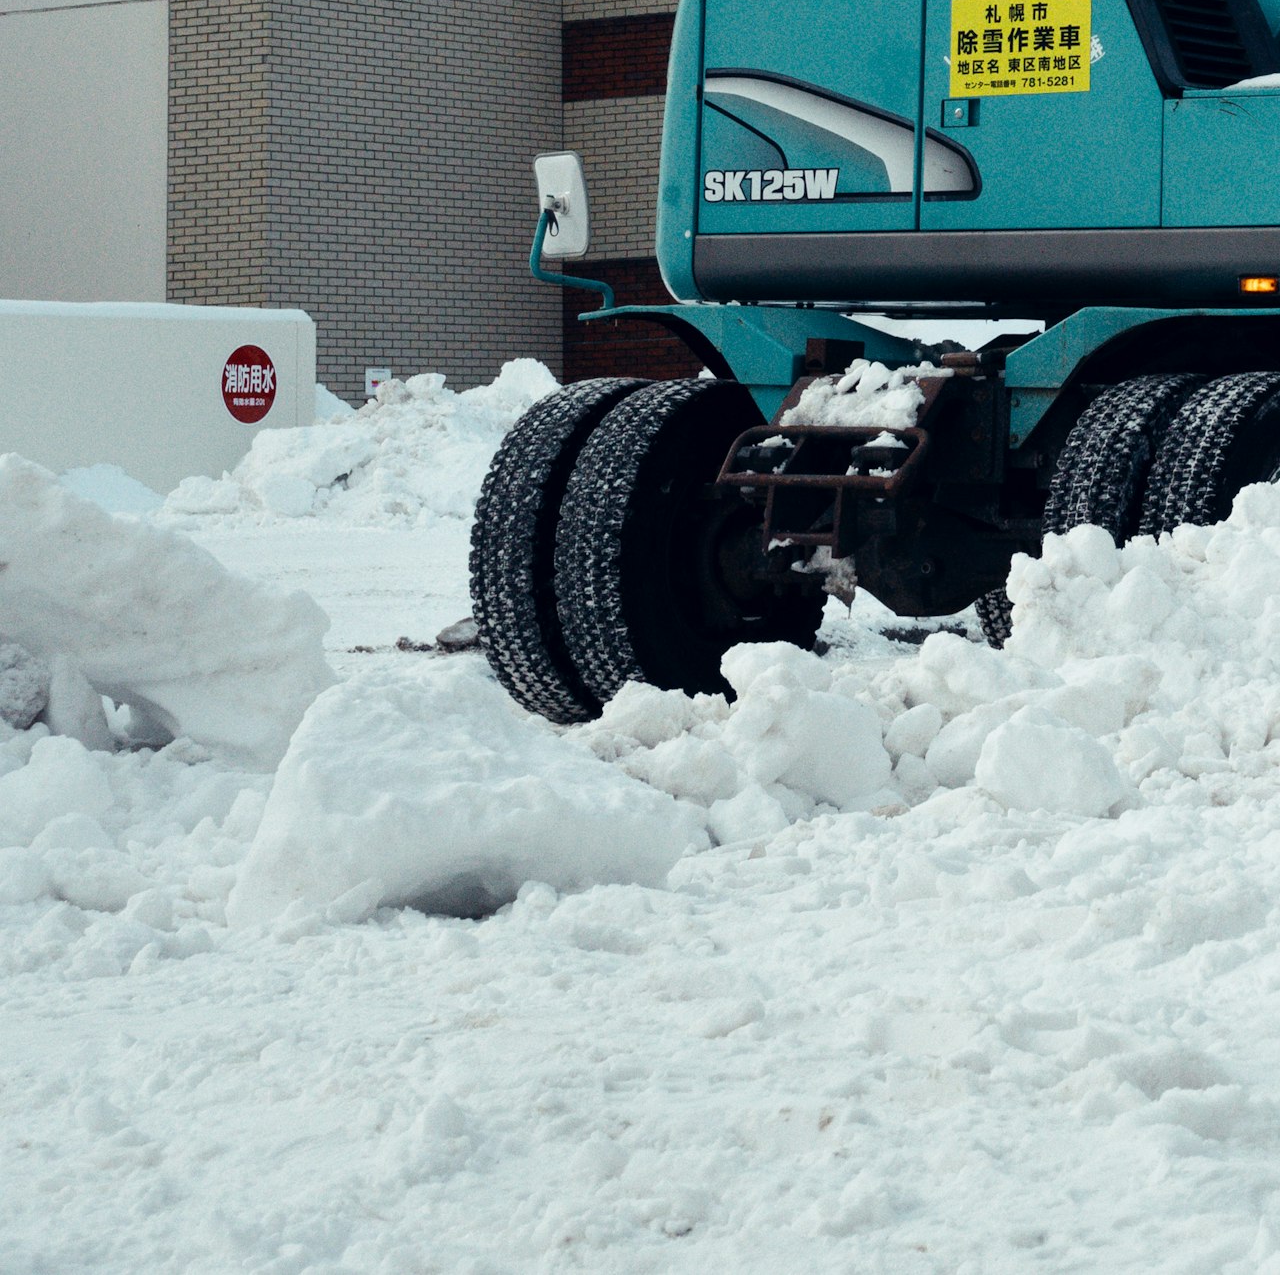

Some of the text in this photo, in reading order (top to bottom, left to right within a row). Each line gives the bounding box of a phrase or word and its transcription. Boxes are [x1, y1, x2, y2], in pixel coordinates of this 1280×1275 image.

[985, 2, 1049, 24] 札幌市
[957, 24, 1081, 56] 除雪作業車
[957, 55, 1081, 75] 地区名 東区南地区
[964, 75, 1075, 90] センター電話番号 781-5281
[704, 169, 839, 202] SK125W
[225, 364, 275, 393] 消防用水
